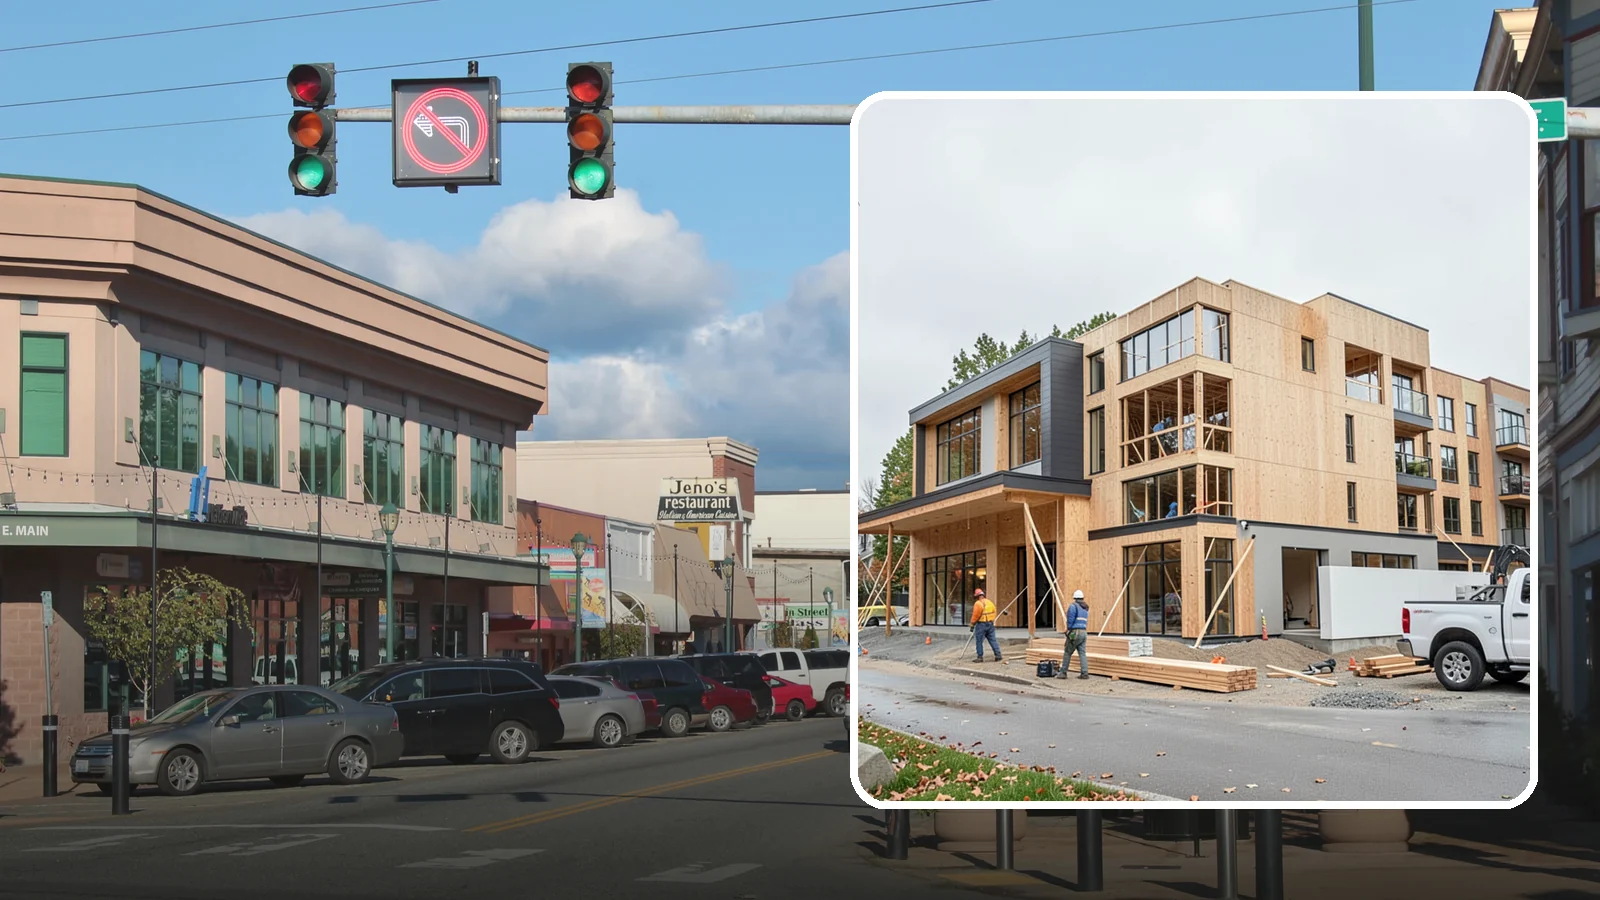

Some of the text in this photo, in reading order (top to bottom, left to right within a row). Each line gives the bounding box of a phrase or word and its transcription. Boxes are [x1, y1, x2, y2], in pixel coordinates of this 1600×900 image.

[670, 480, 727, 494] Jeno's
[665, 497, 731, 508] restaurant
[659, 510, 682, 519] Italian
[686, 510, 714, 518] American
[715, 509, 737, 519] Cuisine
[2, 525, 49, 536] E. MAIN
[797, 606, 828, 616] Street
[791, 619, 823, 627] lass
